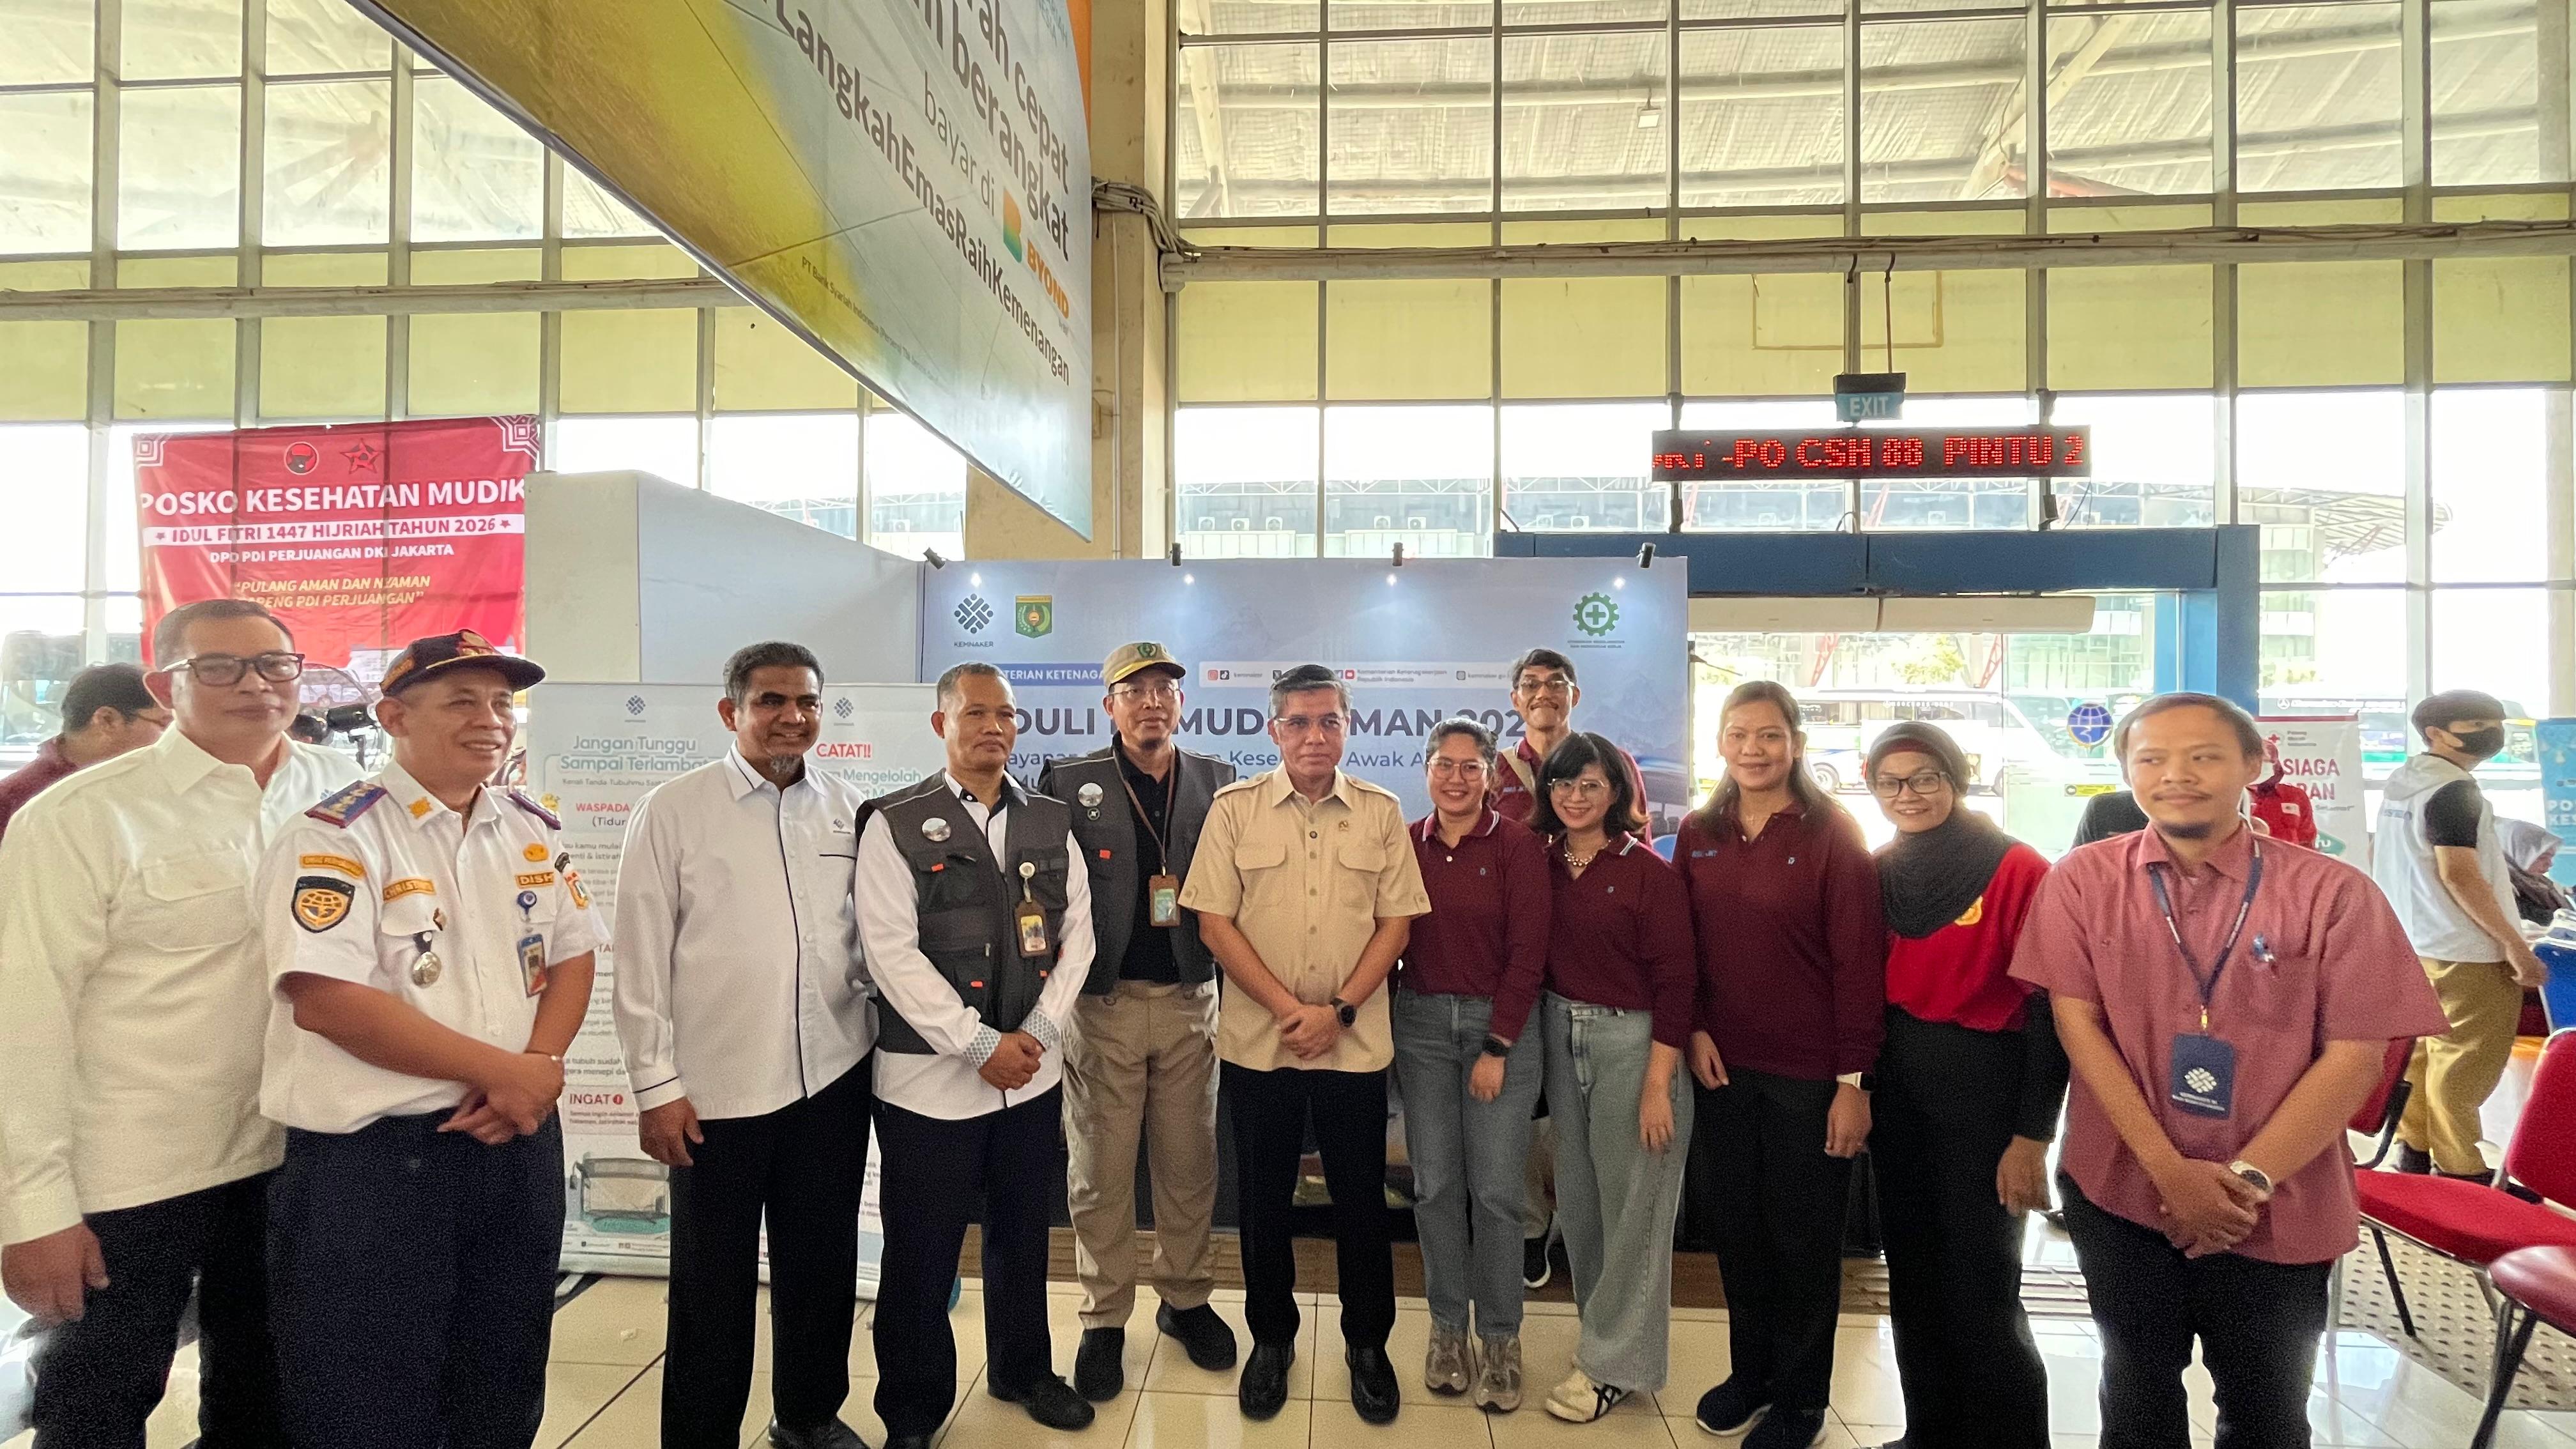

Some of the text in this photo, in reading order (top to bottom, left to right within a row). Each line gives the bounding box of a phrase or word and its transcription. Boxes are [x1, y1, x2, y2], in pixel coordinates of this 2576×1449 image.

[952, 0, 1069, 261] berangkat
[924, 70, 995, 216] bayar di
[802, 256, 811, 273] PT
[1027, 240, 1070, 319] BYOND
[1850, 397, 1888, 417] EXIT
[1795, 437, 1872, 468] CSH
[1943, 436, 2053, 466] PINTU
[2064, 436, 2084, 465] 2
[139, 479, 525, 516] POSKO KESEHATAN MUDIK
[172, 518, 495, 542] IDUL FITRI 1447 HIJRIAH TAHUN 2026
[210, 544, 454, 562] DPD PDI PERJUANGAN DKI JAKARTA
[299, 578, 339, 592] AMAN
[342, 577, 371, 590] DAN
[373, 575, 431, 589] NYAMAN
[296, 595, 320, 607] PDI
[1004, 669, 1104, 680] TERIAN KETENAGA
[1016, 707, 1095, 735] DULI
[1350, 709, 1442, 737] MAN
[573, 735, 696, 755] Jangan Tunggu
[561, 756, 623, 773] Sampai
[1230, 750, 1280, 766] Kese
[1346, 750, 1404, 767] Awak
[1410, 751, 1425, 767] A
[2283, 758, 2340, 776] SIAGA
[843, 768, 921, 785] Mengelolah
[576, 802, 630, 813] WASPADA
[519, 873, 554, 885] DISH
[569, 1093, 611, 1105] INGAT
